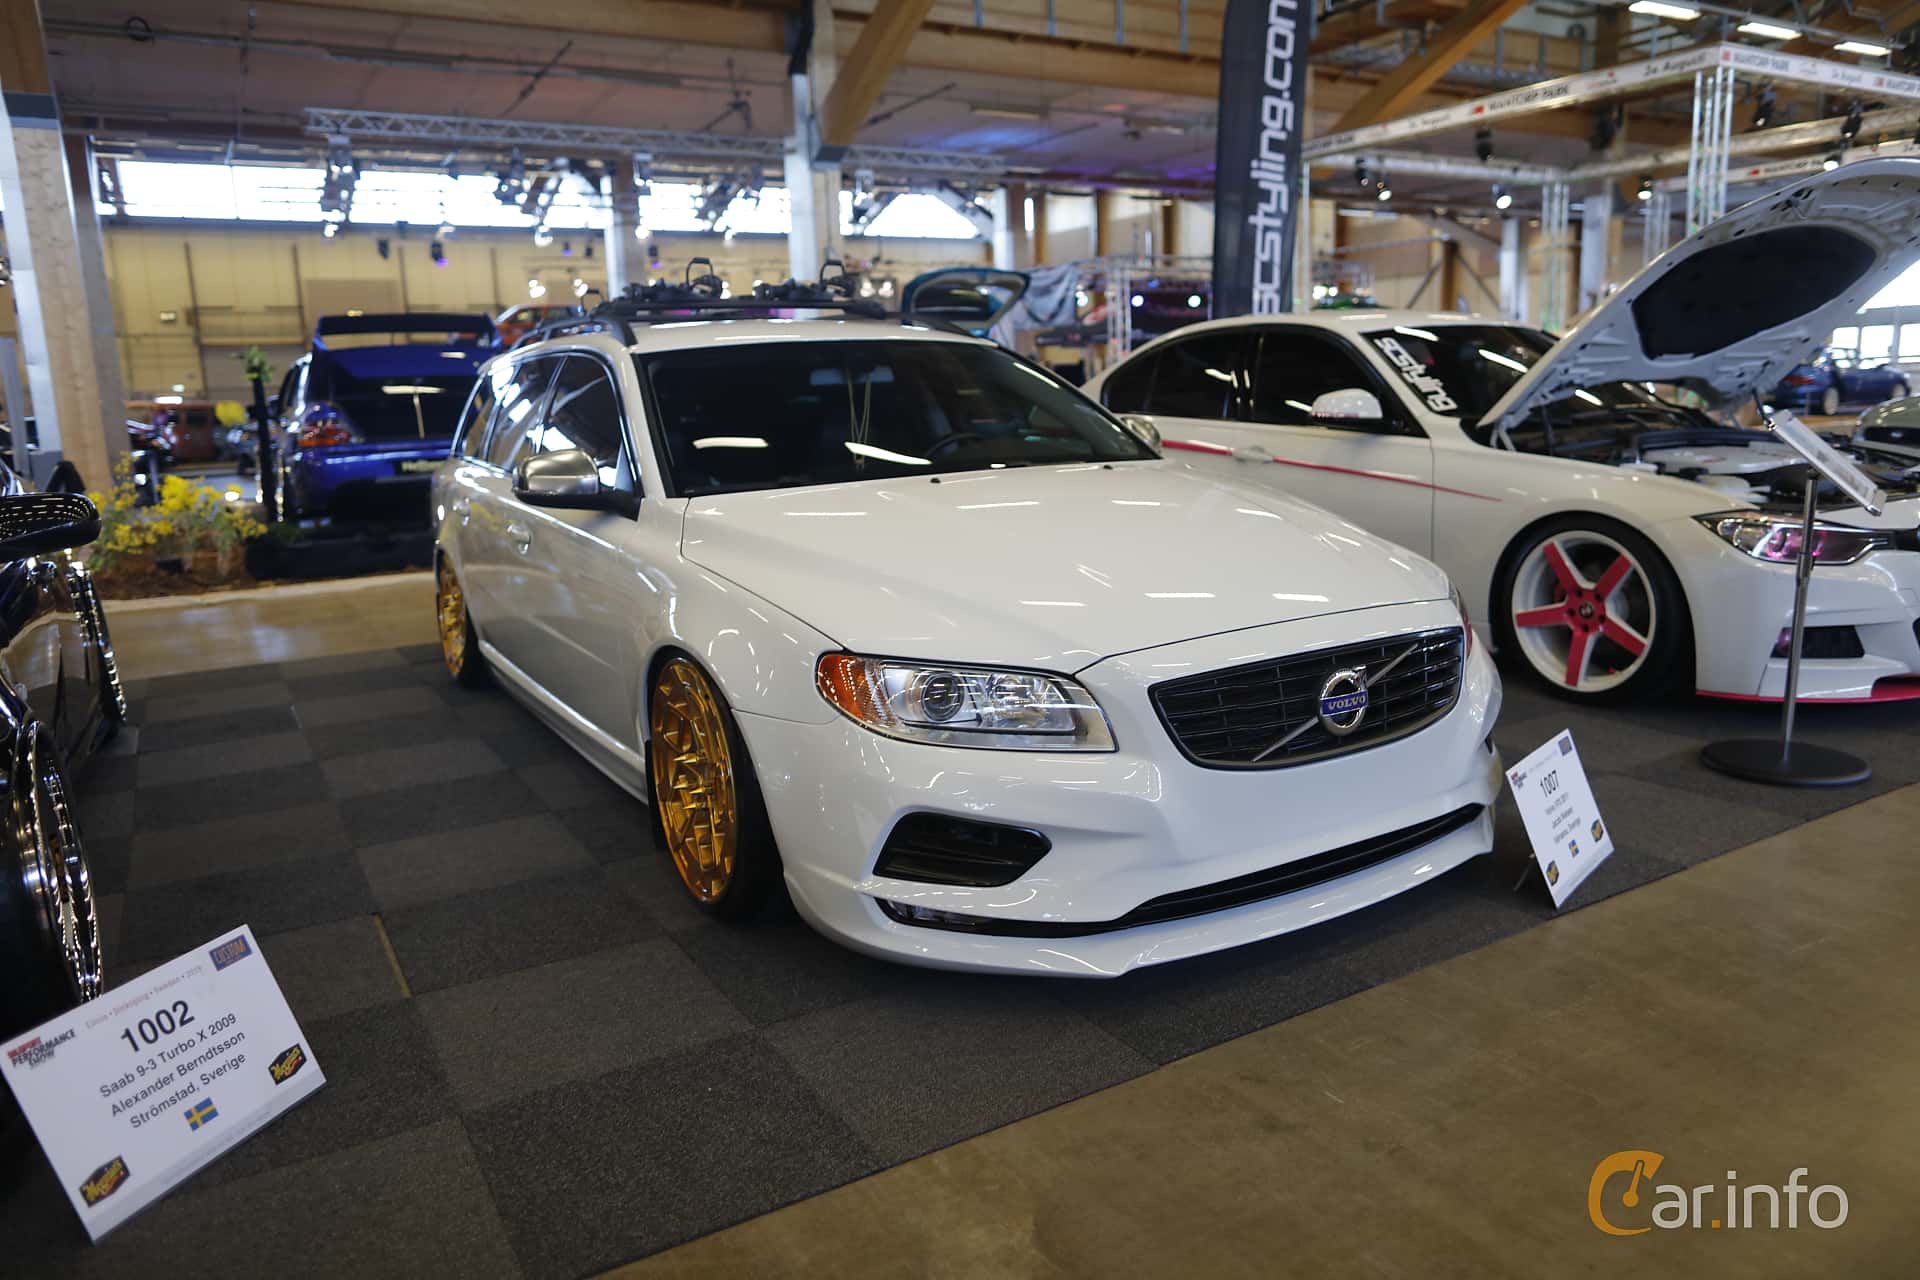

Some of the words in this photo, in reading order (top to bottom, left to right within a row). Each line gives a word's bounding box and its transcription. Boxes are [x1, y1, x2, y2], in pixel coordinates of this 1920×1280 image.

[1328, 695, 1366, 710] VOLVO
[1538, 769, 1561, 798] 1007
[11, 1028, 76, 1068] PERFORMANCE
[121, 1000, 196, 1053] 1002
[100, 1071, 135, 1098] Saab
[136, 1058, 157, 1077] 9-3
[158, 1038, 196, 1064] Turbo
[196, 1029, 208, 1043] X
[209, 1013, 237, 1036] 2009
[112, 1071, 175, 1117] Alexander
[176, 1031, 246, 1077] Berndtsson
[130, 1081, 201, 1128] Strömstad,
[200, 1052, 247, 1086] Sverige
